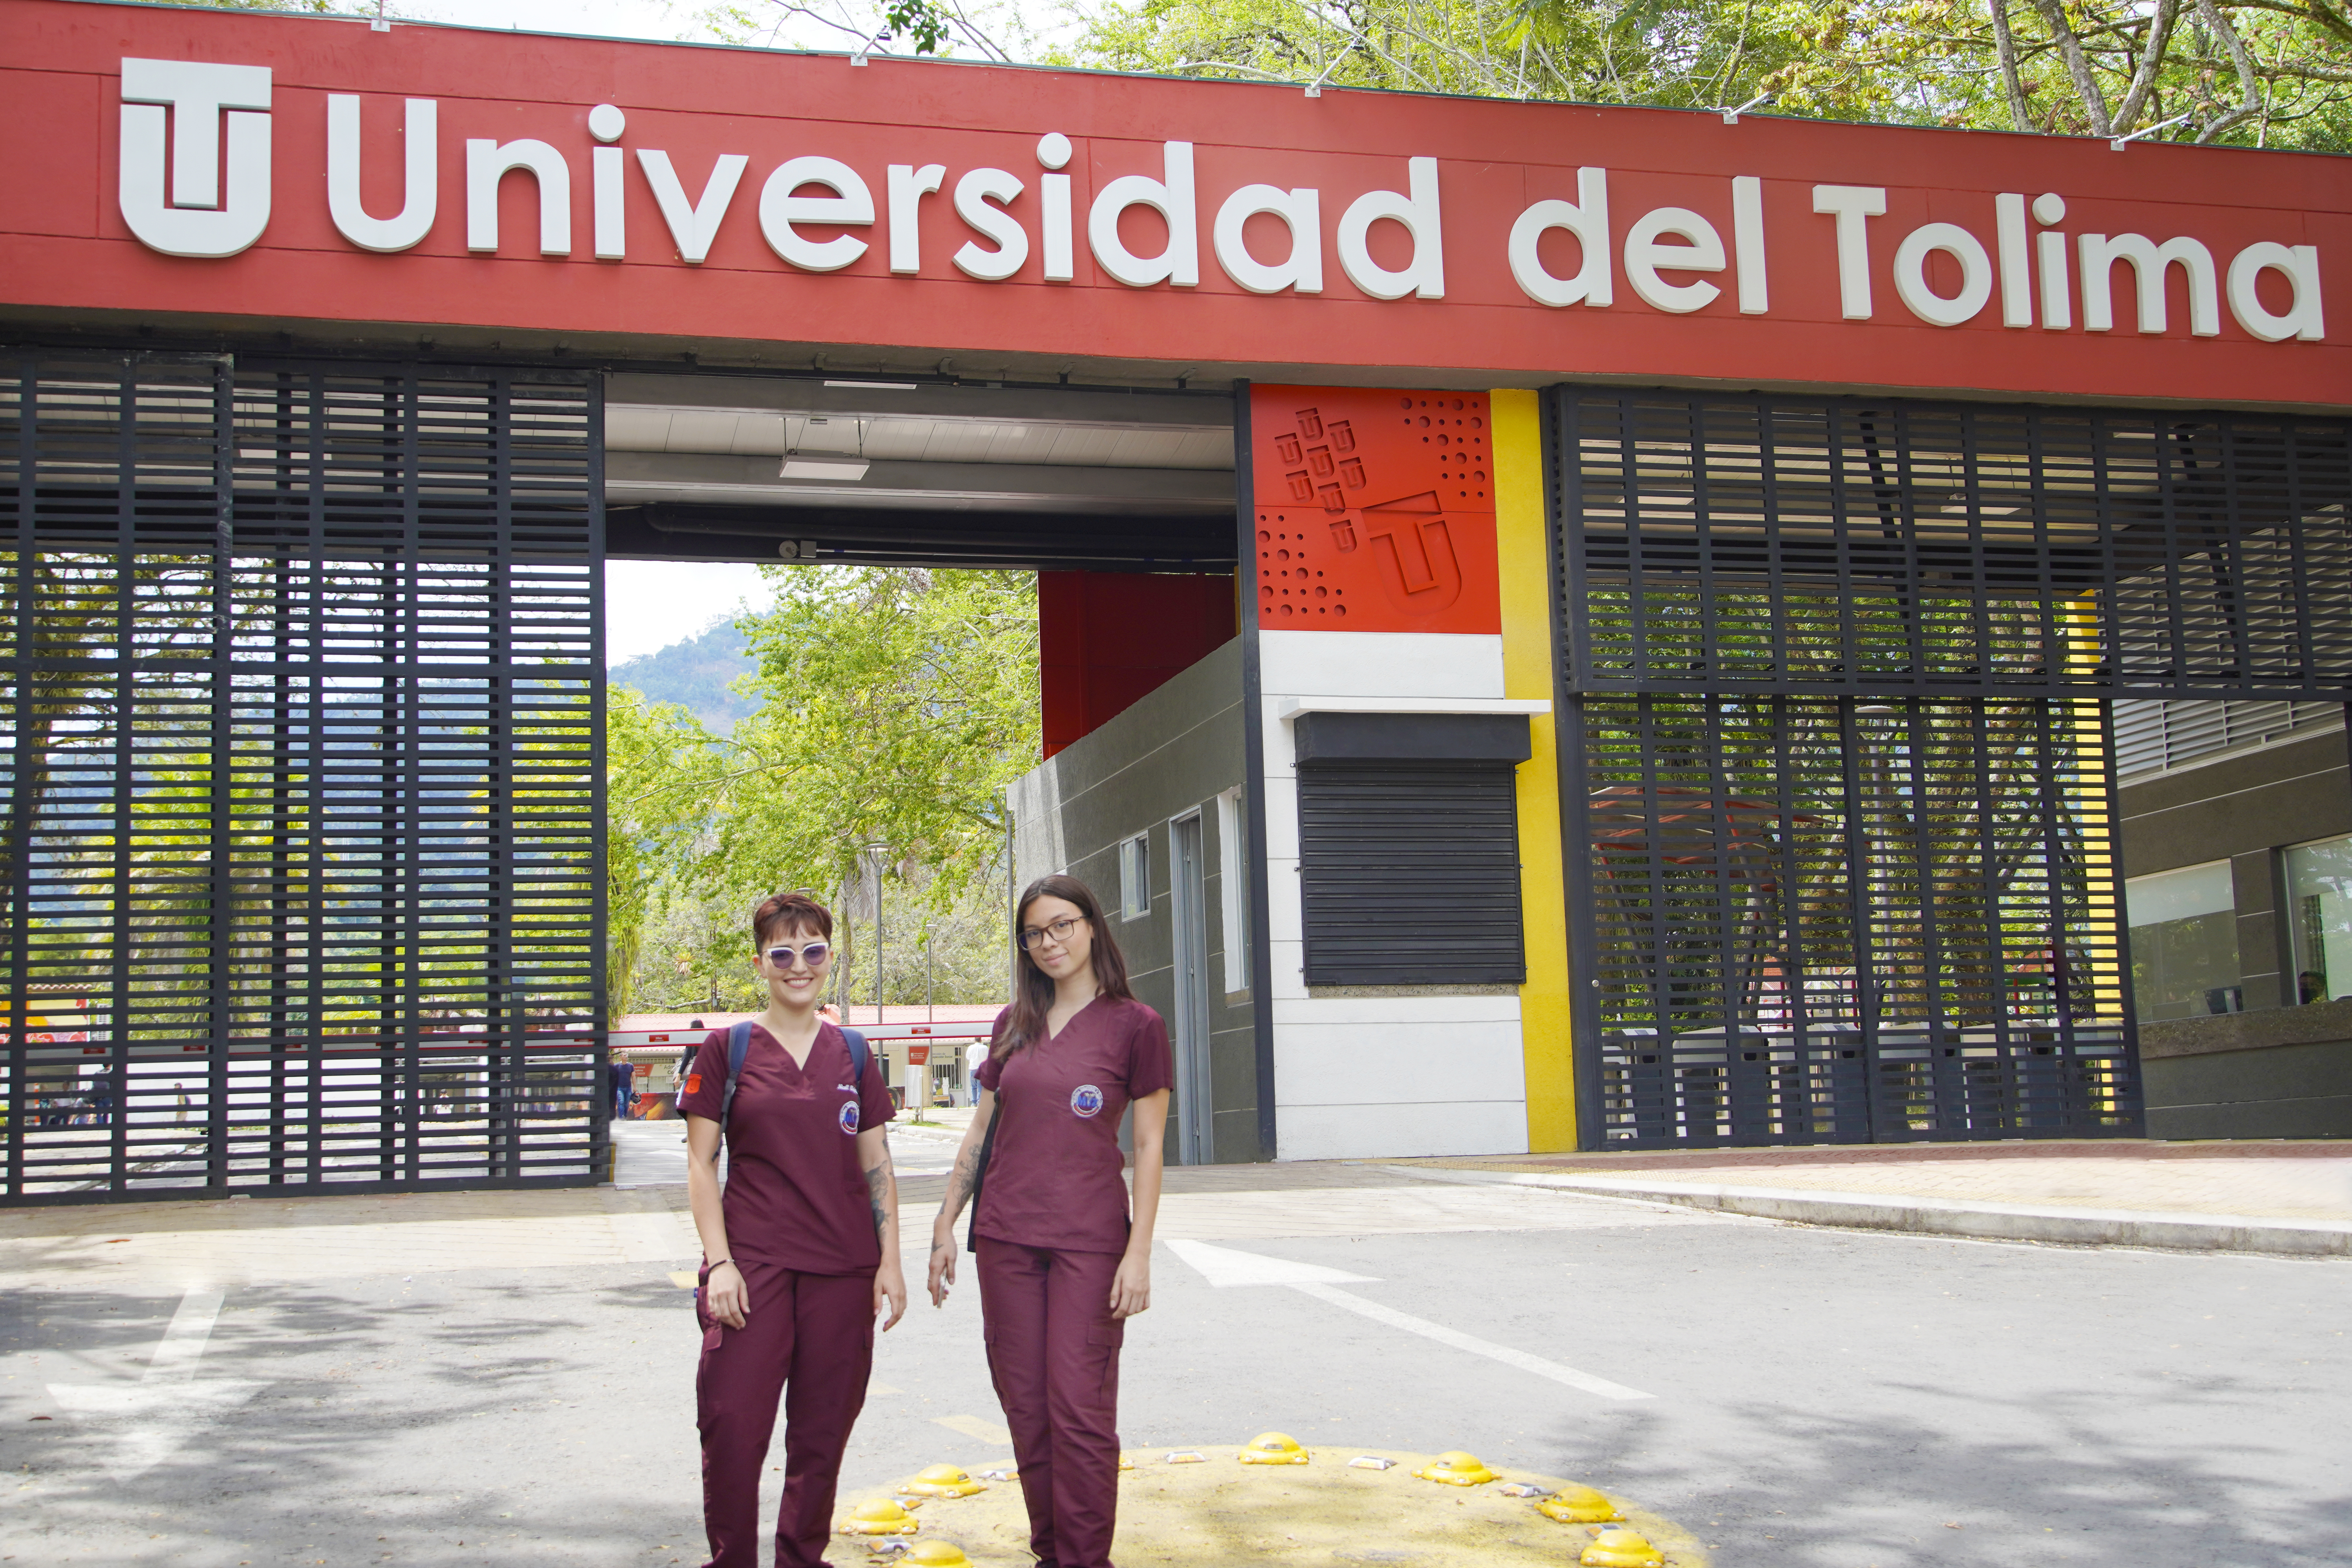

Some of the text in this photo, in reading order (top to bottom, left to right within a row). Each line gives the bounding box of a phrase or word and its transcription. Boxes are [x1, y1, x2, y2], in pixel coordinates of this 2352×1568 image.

[328, 94, 1445, 300] Universidad
[1508, 167, 1767, 314] del
[1813, 184, 2325, 342] Tolima
